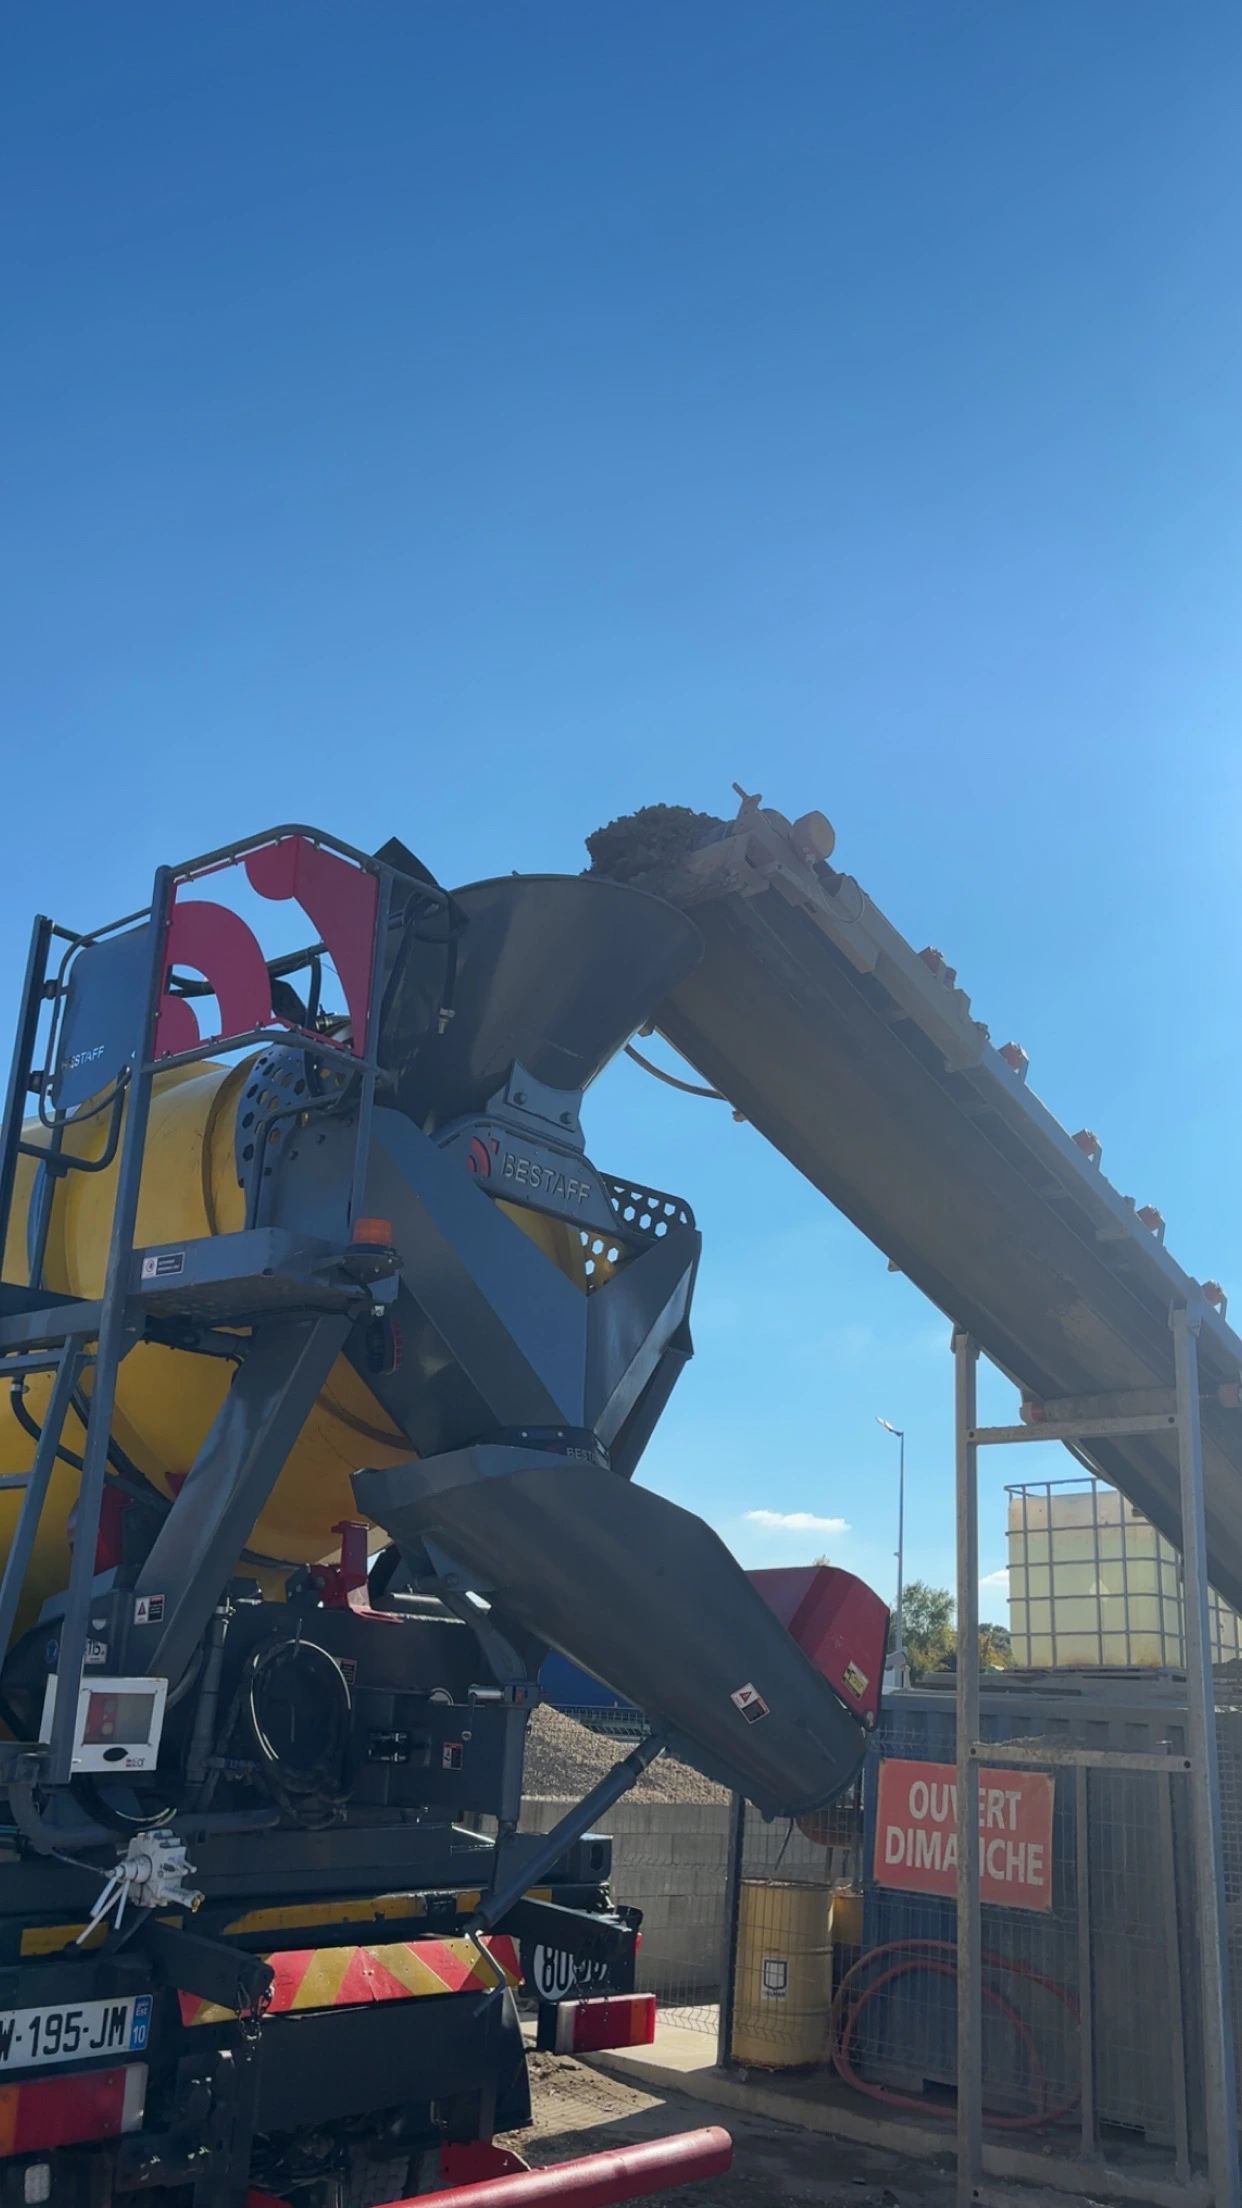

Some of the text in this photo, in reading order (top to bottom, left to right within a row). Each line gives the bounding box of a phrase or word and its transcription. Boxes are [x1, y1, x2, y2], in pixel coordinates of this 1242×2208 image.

[61, 1044, 105, 1070] STAFF
[501, 1153, 591, 1205] BESTAFF
[132, 2024, 147, 2044] 10
